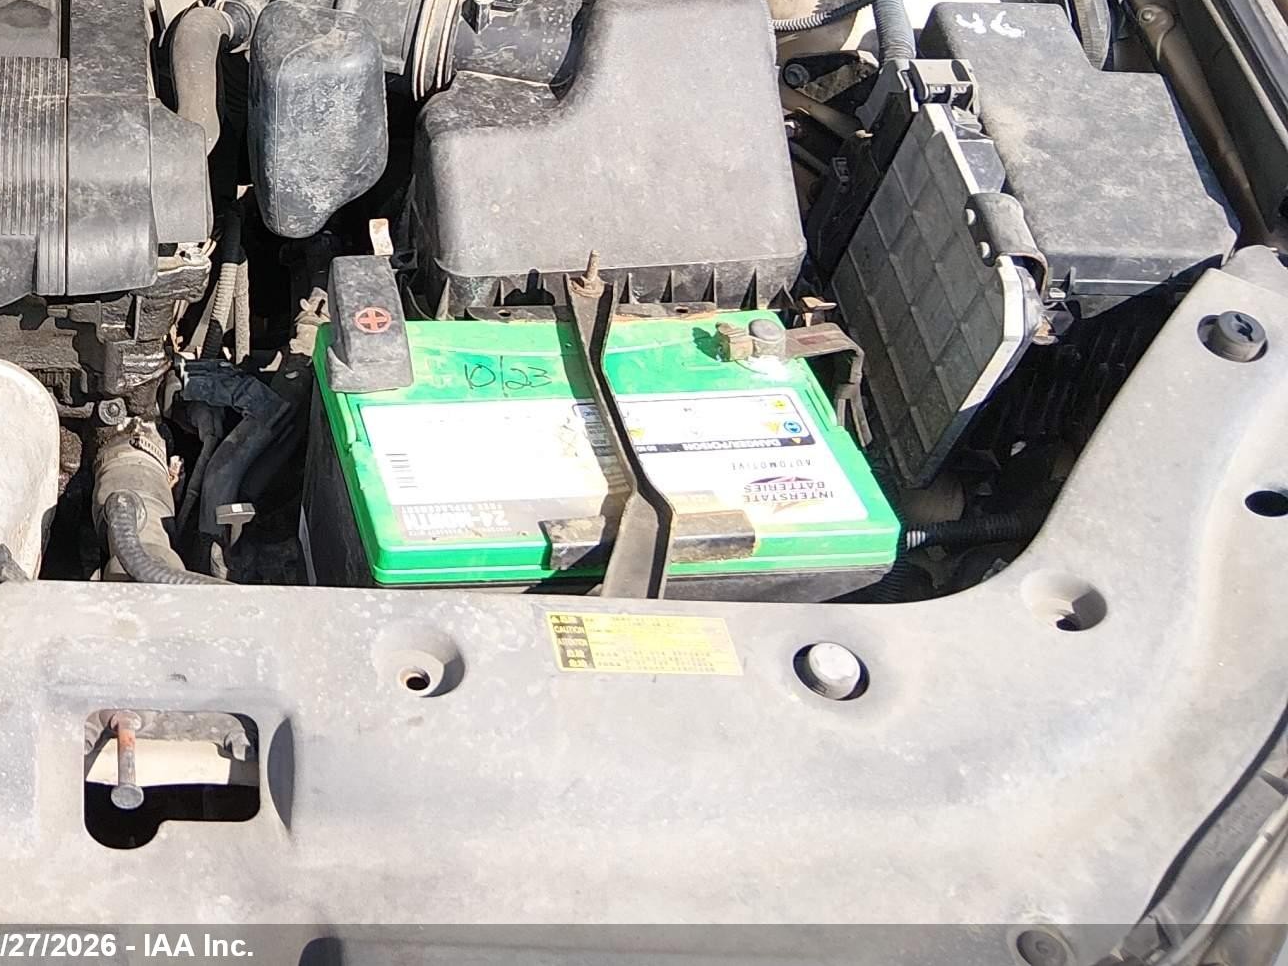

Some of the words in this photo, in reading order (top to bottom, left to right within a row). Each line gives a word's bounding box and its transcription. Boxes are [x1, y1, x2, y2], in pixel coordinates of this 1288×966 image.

[682, 438, 781, 452] DANGER/POISON
[743, 480, 826, 494] BATTERIES
[742, 490, 834, 505] INTERSTATE
[402, 510, 508, 530] 24-MONTH
